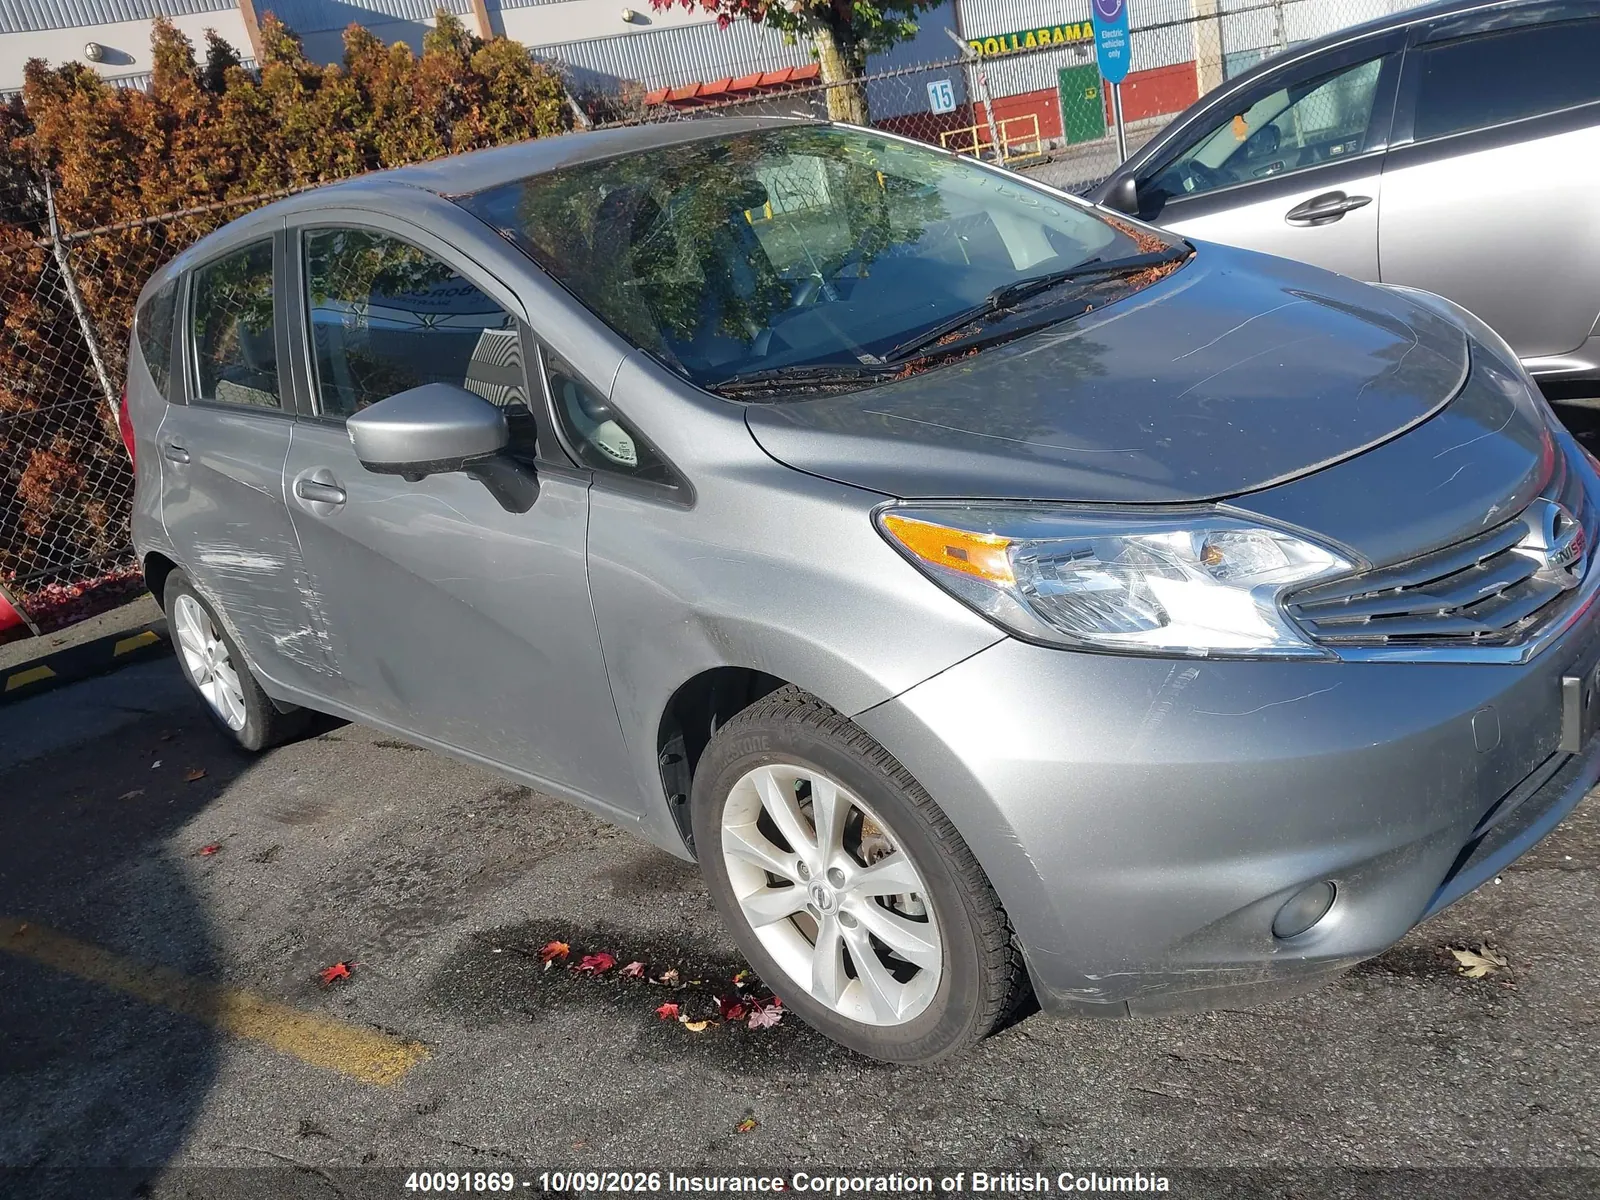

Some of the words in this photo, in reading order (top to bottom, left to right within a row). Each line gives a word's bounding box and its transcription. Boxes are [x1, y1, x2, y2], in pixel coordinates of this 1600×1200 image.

[1101, 29, 1123, 39] Electric
[969, 22, 1094, 57] DOLLARAMA
[1101, 39, 1125, 49] vehicles
[1107, 50, 1121, 60] only
[931, 84, 952, 109] 15
